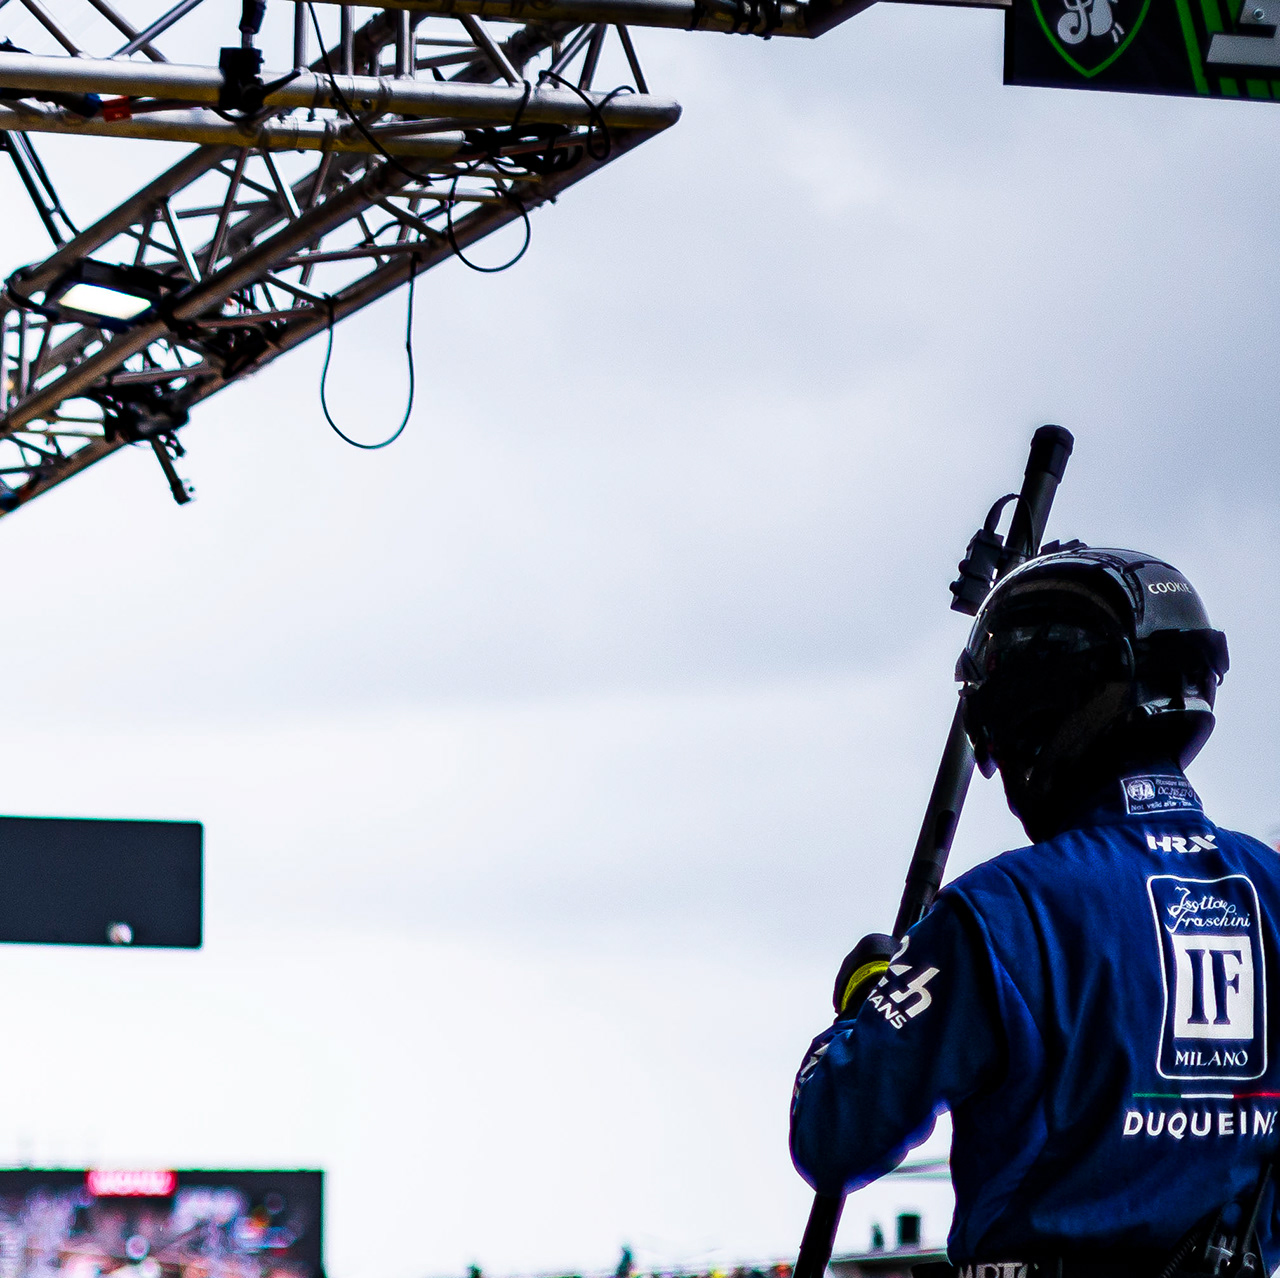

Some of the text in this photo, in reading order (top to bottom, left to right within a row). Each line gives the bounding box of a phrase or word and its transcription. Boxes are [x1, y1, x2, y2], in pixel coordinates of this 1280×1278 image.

[1147, 581, 1192, 595] COOKIE
[1146, 834, 1219, 854] HRX
[1164, 906, 1251, 934] Fraschini
[1184, 948, 1243, 1026] IF
[1174, 1050, 1249, 1068] MILANO
